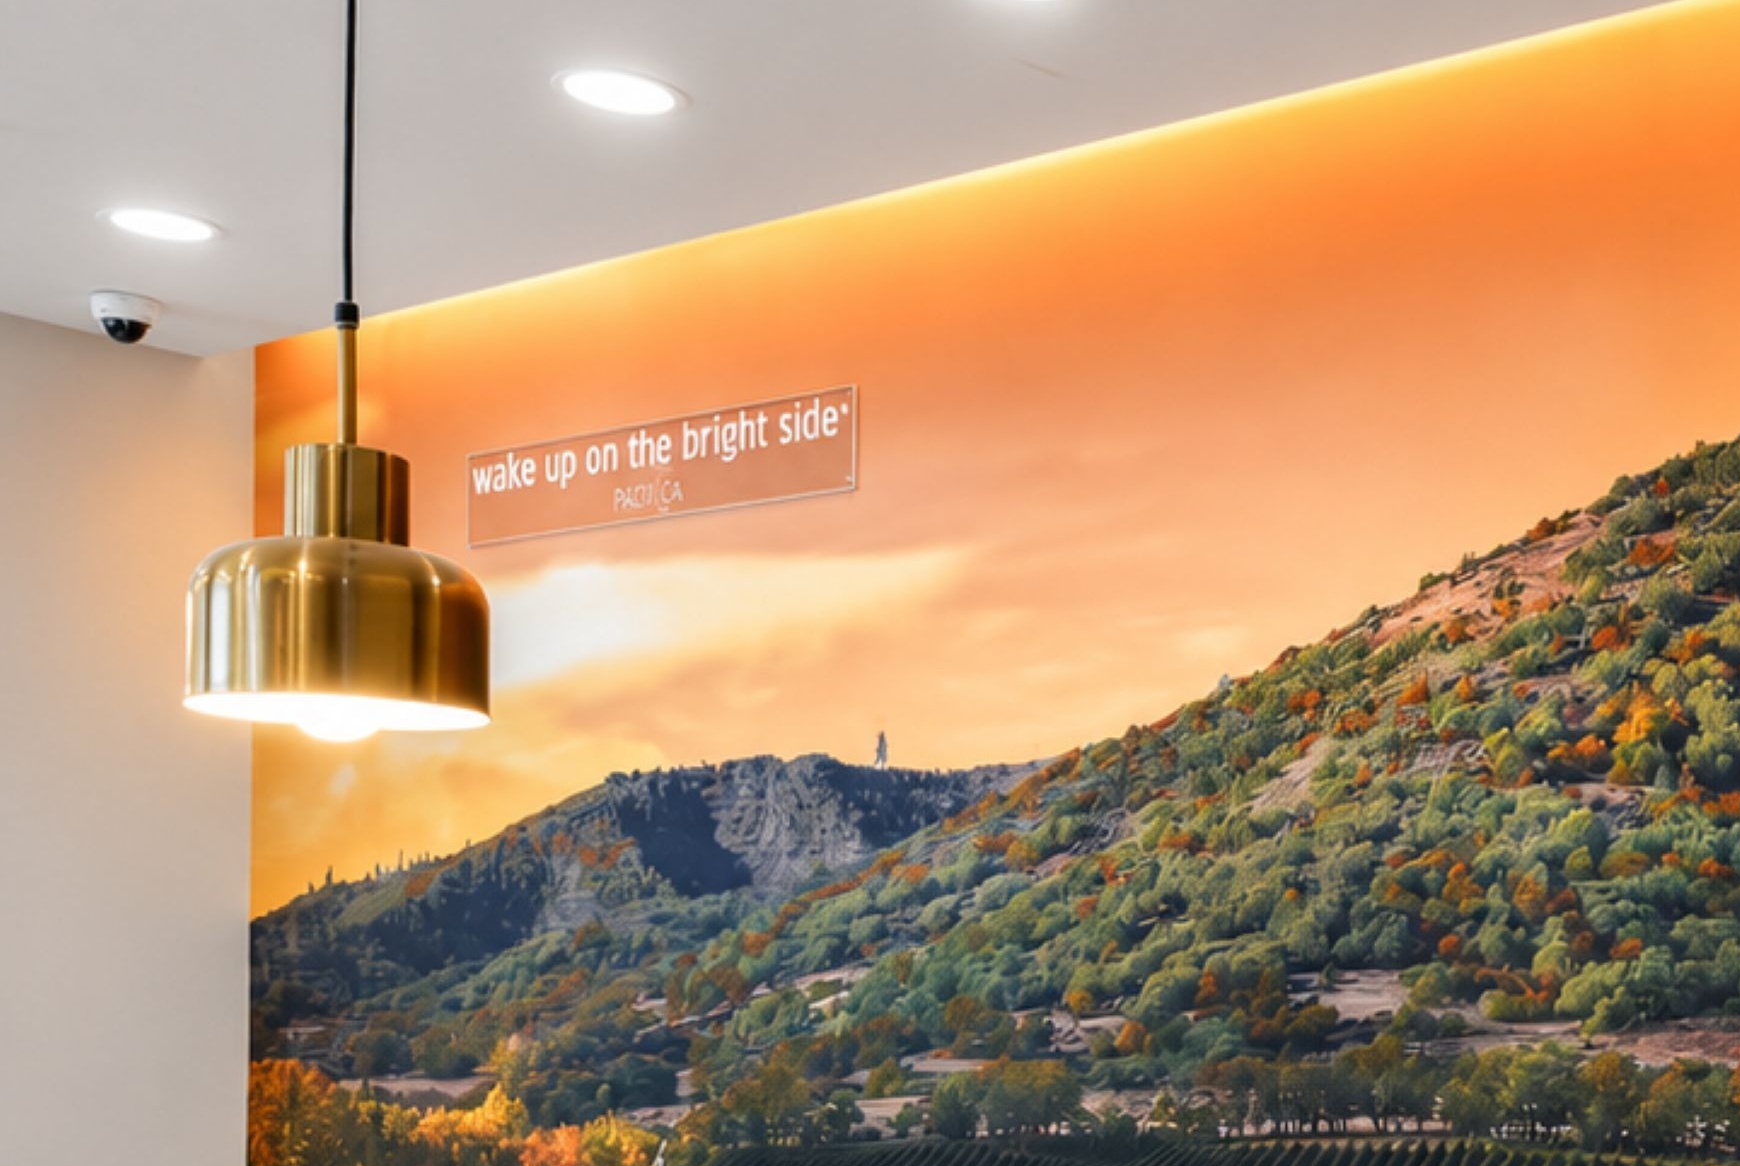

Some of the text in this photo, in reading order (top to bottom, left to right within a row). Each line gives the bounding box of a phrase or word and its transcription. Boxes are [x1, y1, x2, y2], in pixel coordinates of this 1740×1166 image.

[472, 452, 536, 495] wake
[545, 453, 577, 489] up
[585, 441, 619, 474] on
[627, 429, 673, 469] the
[682, 408, 769, 462] bright
